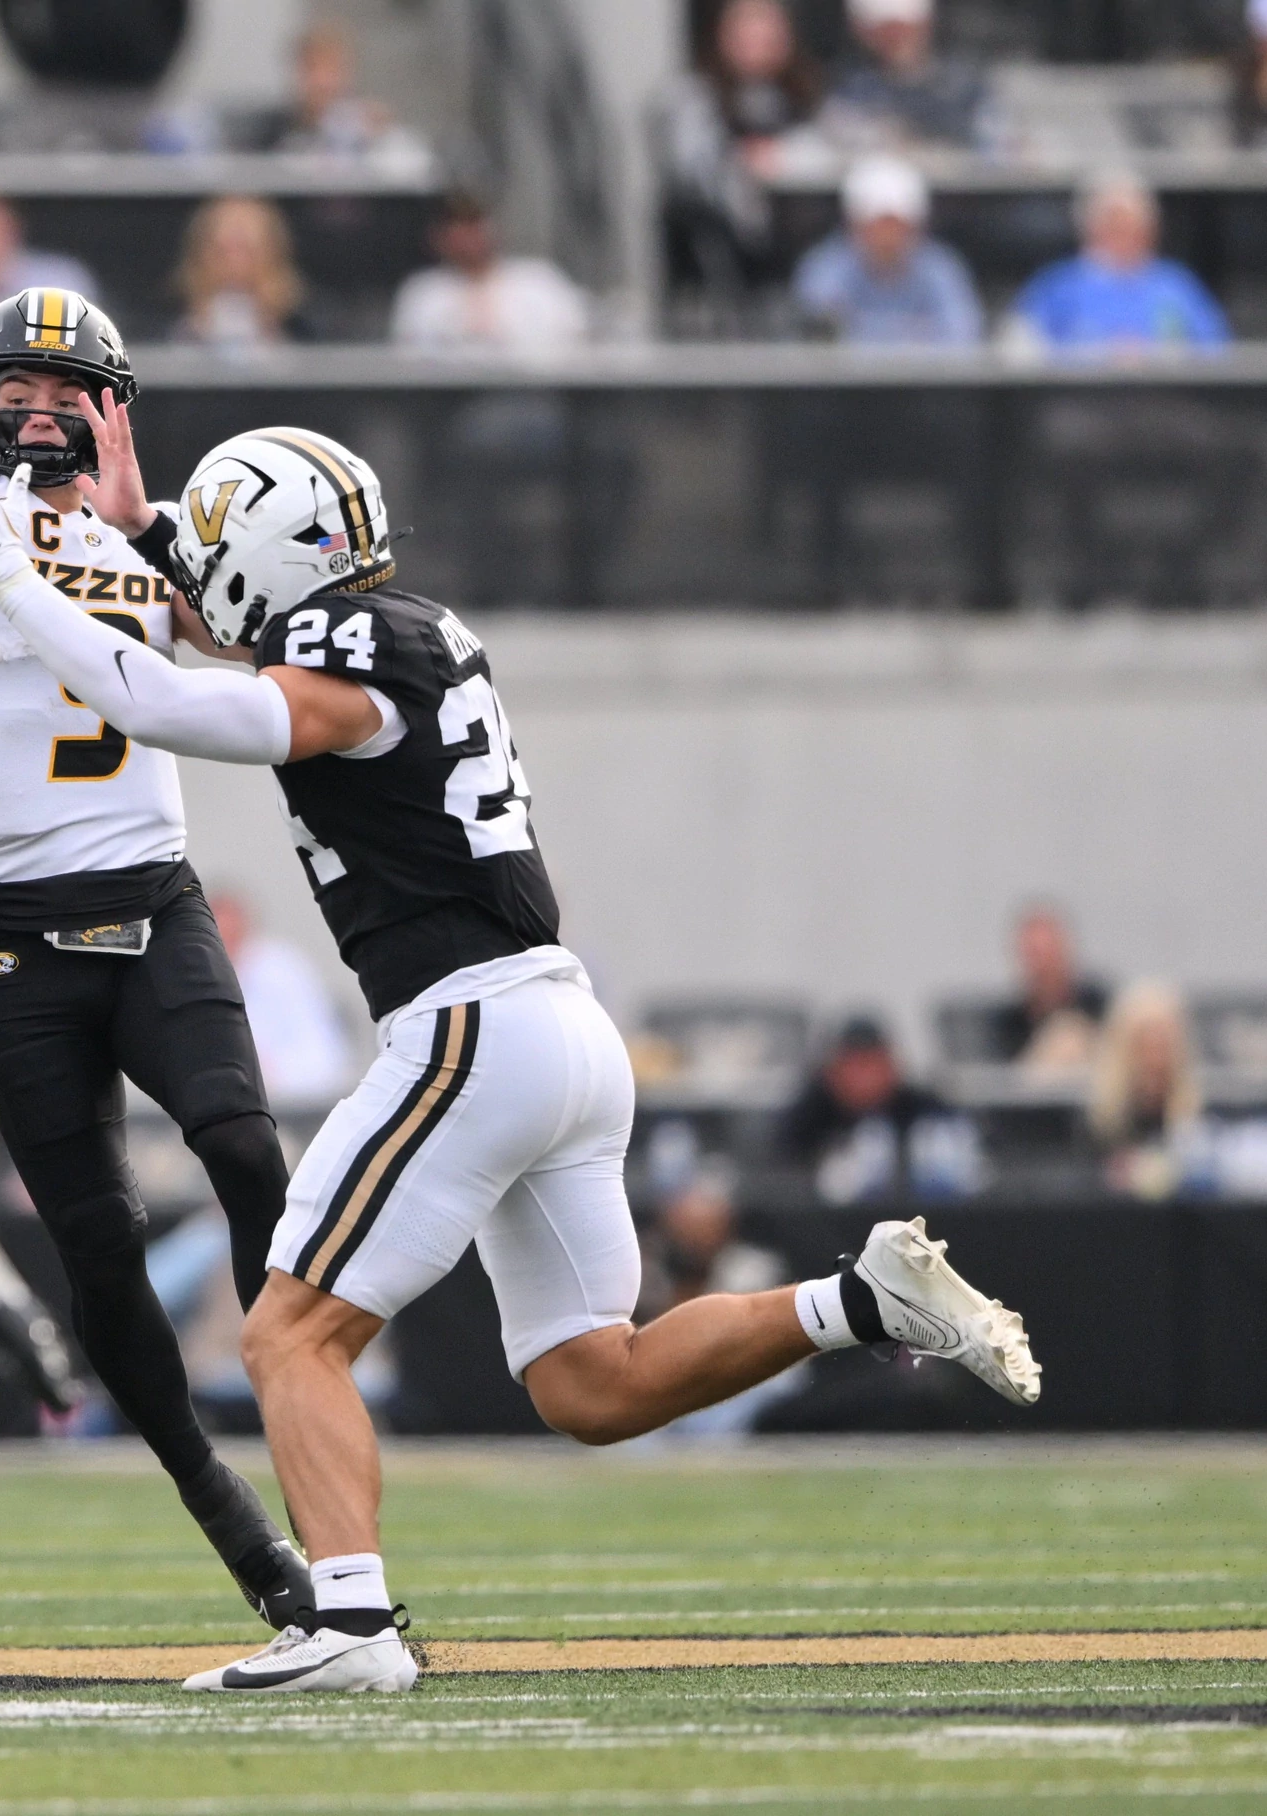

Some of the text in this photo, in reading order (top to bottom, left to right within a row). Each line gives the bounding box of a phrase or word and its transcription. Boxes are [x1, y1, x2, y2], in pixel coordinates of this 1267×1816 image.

[29, 341, 71, 352] MIZZOU
[31, 510, 62, 554] C
[189, 479, 245, 547] V
[30, 558, 171, 606] IZZOU
[328, 562, 396, 593] ANDERB
[330, 553, 349, 574] SEC
[285, 609, 376, 671] 24
